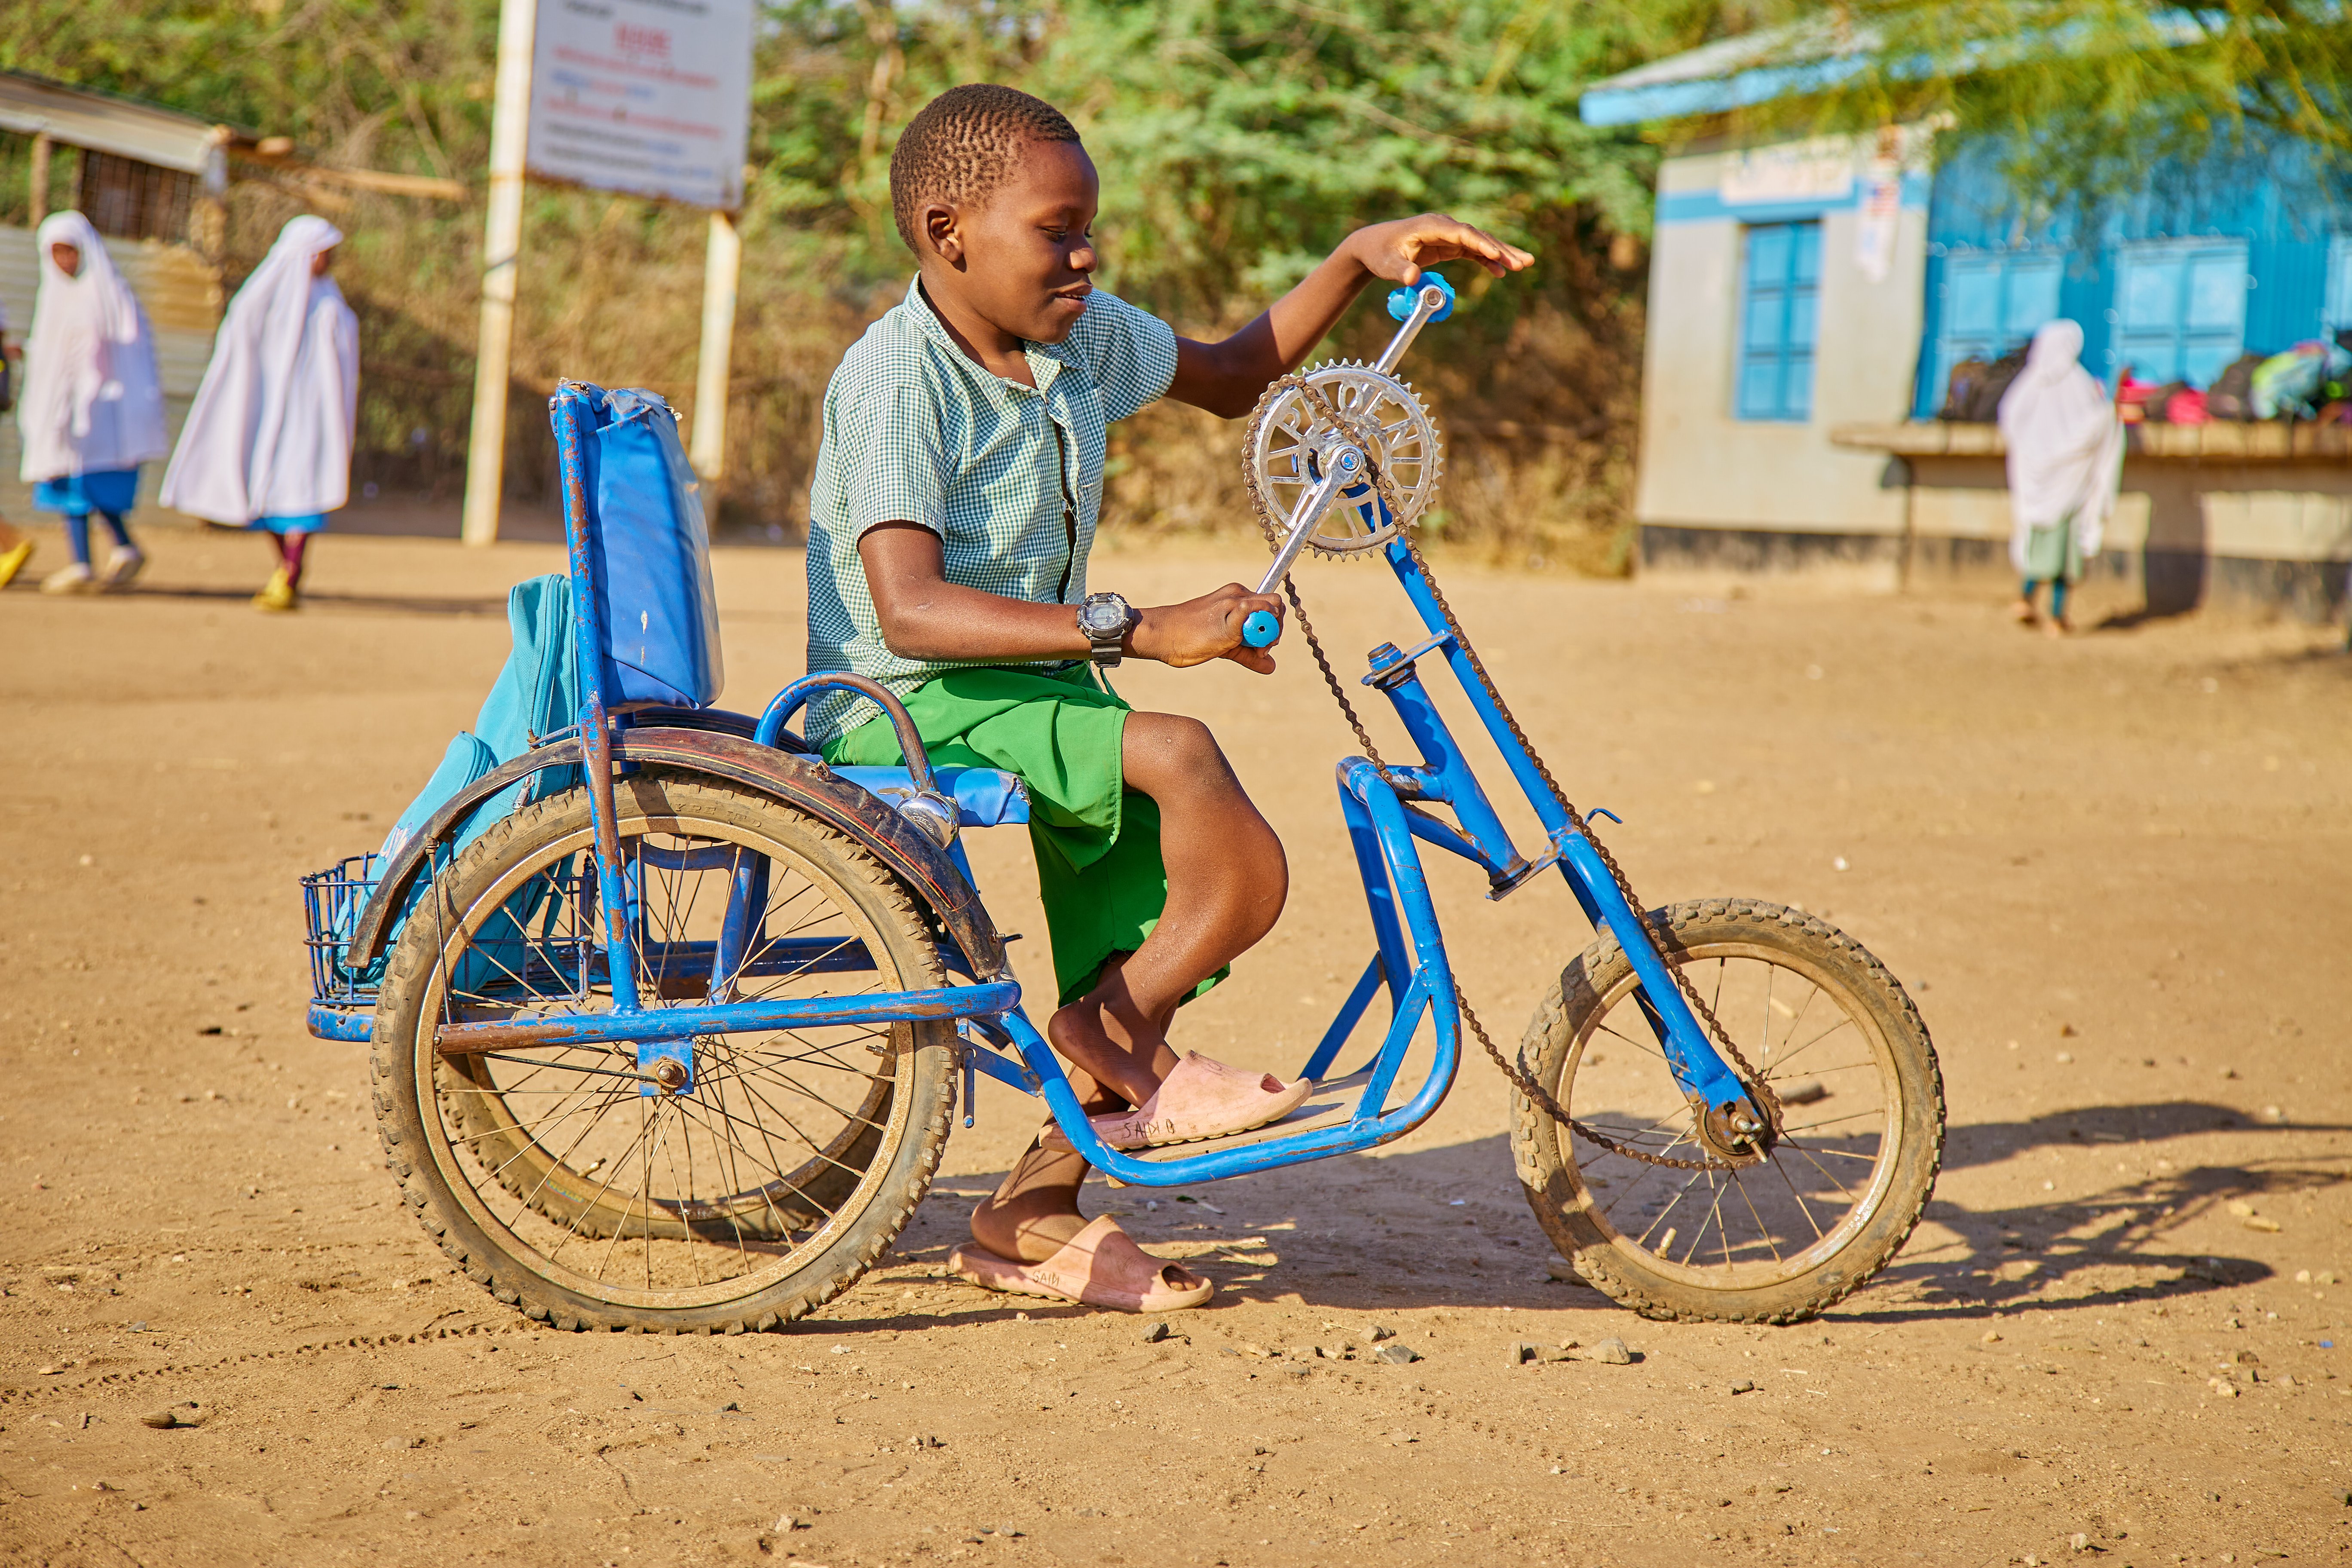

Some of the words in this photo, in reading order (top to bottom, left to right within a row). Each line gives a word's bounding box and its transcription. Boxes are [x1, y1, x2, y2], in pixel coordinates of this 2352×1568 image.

[523, 805, 635, 853] SPEEDS
[1596, 962, 1631, 994] TRADE
[1896, 1042, 1922, 1106] FARMER
[429, 1167, 447, 1196] INFLATE
[1033, 1270, 1060, 1286] SAIDI
